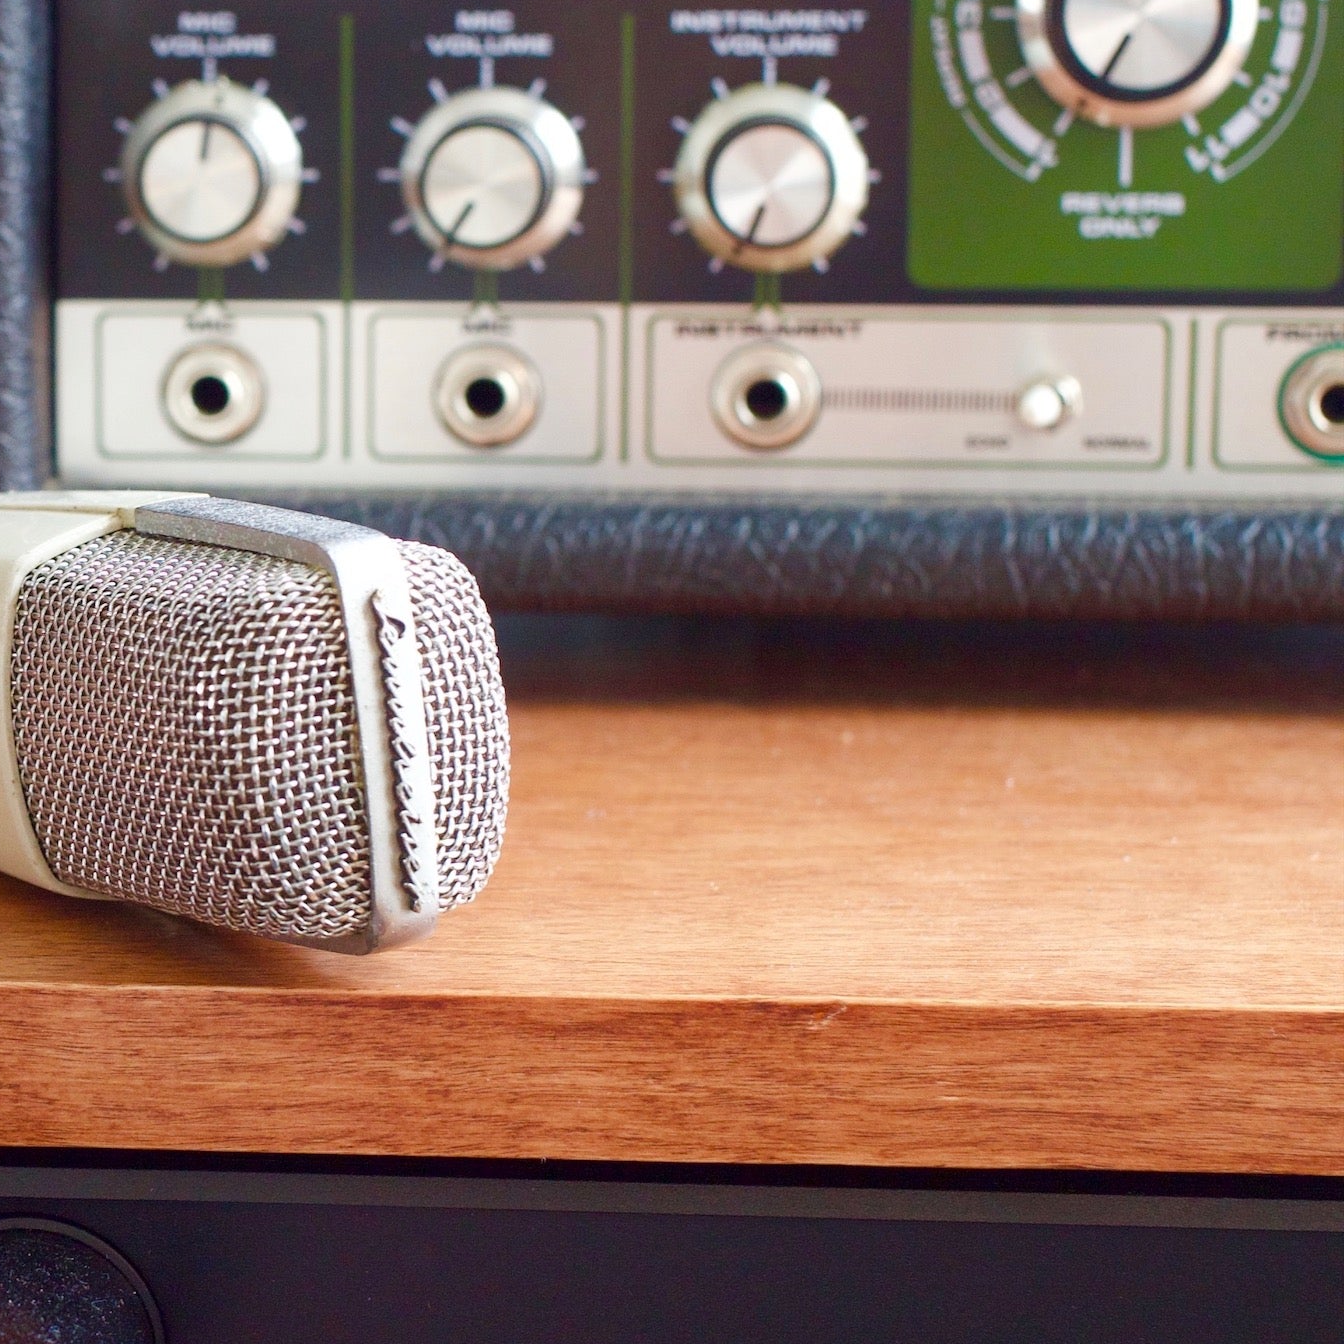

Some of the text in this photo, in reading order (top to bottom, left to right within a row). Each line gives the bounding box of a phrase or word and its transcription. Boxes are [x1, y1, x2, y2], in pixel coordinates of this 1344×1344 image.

[178, 13, 237, 33] MIC
[456, 13, 515, 33] MIC
[670, 12, 866, 32] INSTRUMENT
[151, 35, 275, 56] VOLUME
[426, 35, 553, 56] VOLUME
[710, 34, 838, 56] VOLUME
[1060, 191, 1185, 215] REVERB
[1078, 217, 1161, 239] ONLY
